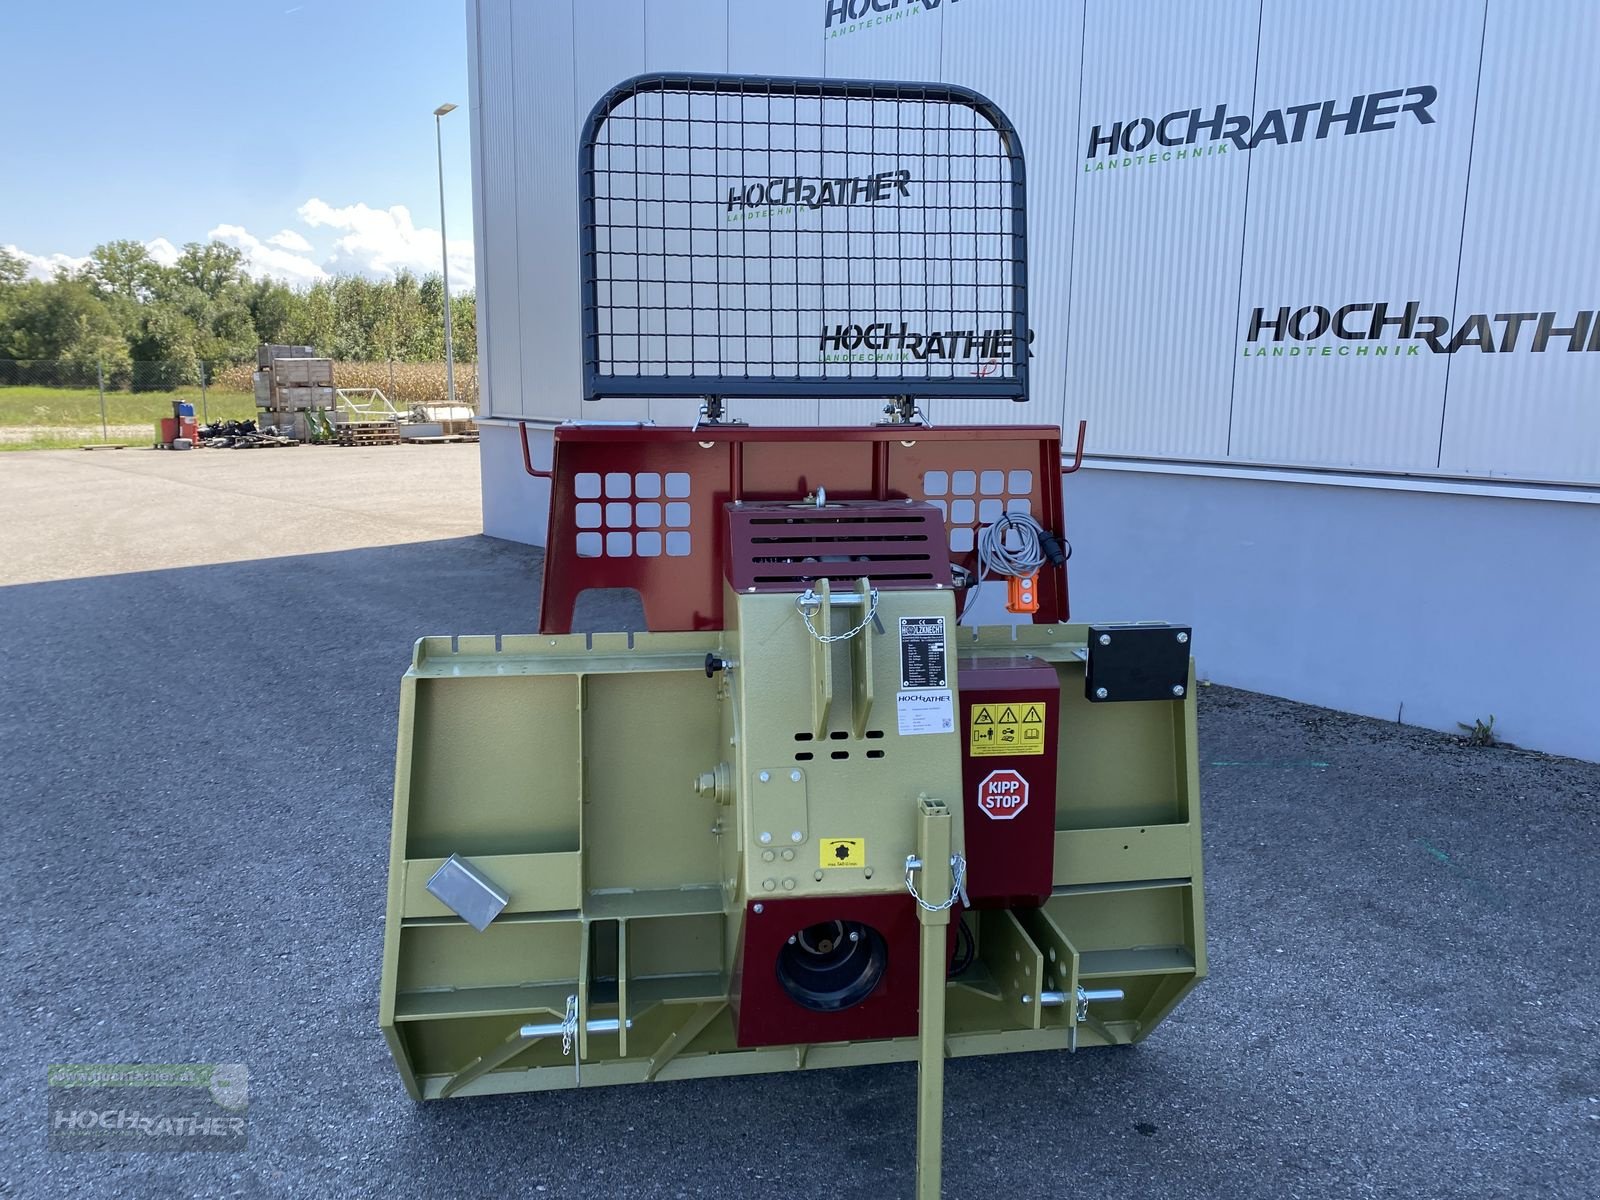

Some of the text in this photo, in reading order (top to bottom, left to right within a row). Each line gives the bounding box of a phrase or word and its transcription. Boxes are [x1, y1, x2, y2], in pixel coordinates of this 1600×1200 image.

[1086, 85, 1438, 159] HOCHRATHER
[1084, 143, 1229, 173] LANDTECHNIK
[727, 169, 912, 212] HOCHRATHER
[1246, 301, 1600, 354] HOCHRATH
[1243, 345, 1420, 357] LANDTECHNIK
[898, 695, 951, 703] HOCHRATHER
[988, 781, 1020, 794] KIPP
[986, 795, 1020, 808] STOP
